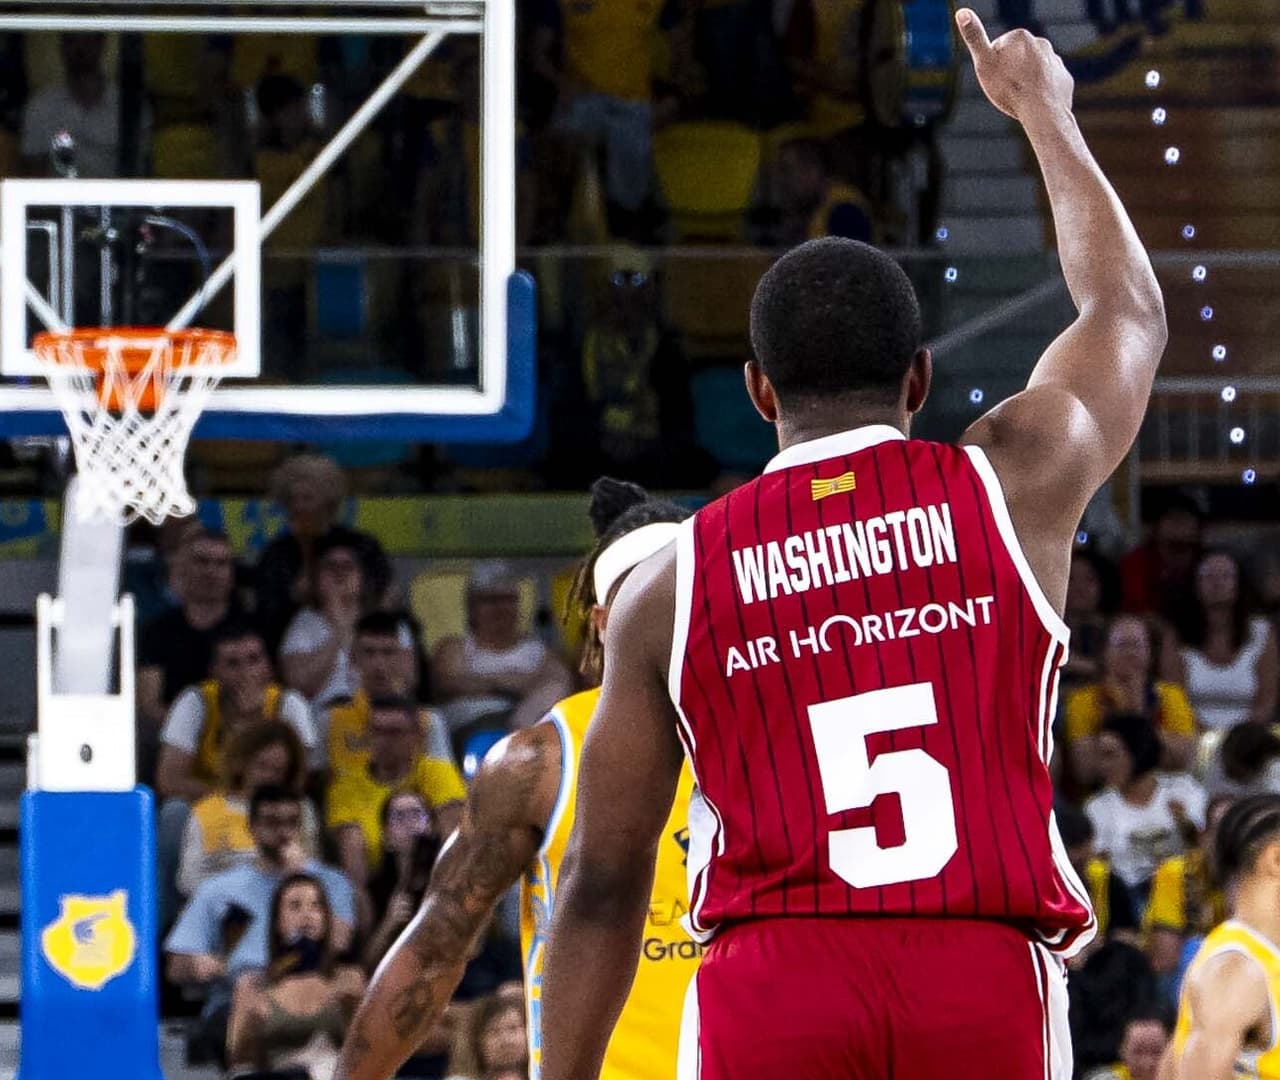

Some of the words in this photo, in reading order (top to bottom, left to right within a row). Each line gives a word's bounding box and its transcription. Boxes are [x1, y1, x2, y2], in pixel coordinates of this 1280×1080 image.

[732, 502, 958, 604] WASHINGTON
[726, 636, 780, 677] AIR
[789, 596, 995, 658] HORIZONT
[807, 681, 959, 889] 5
